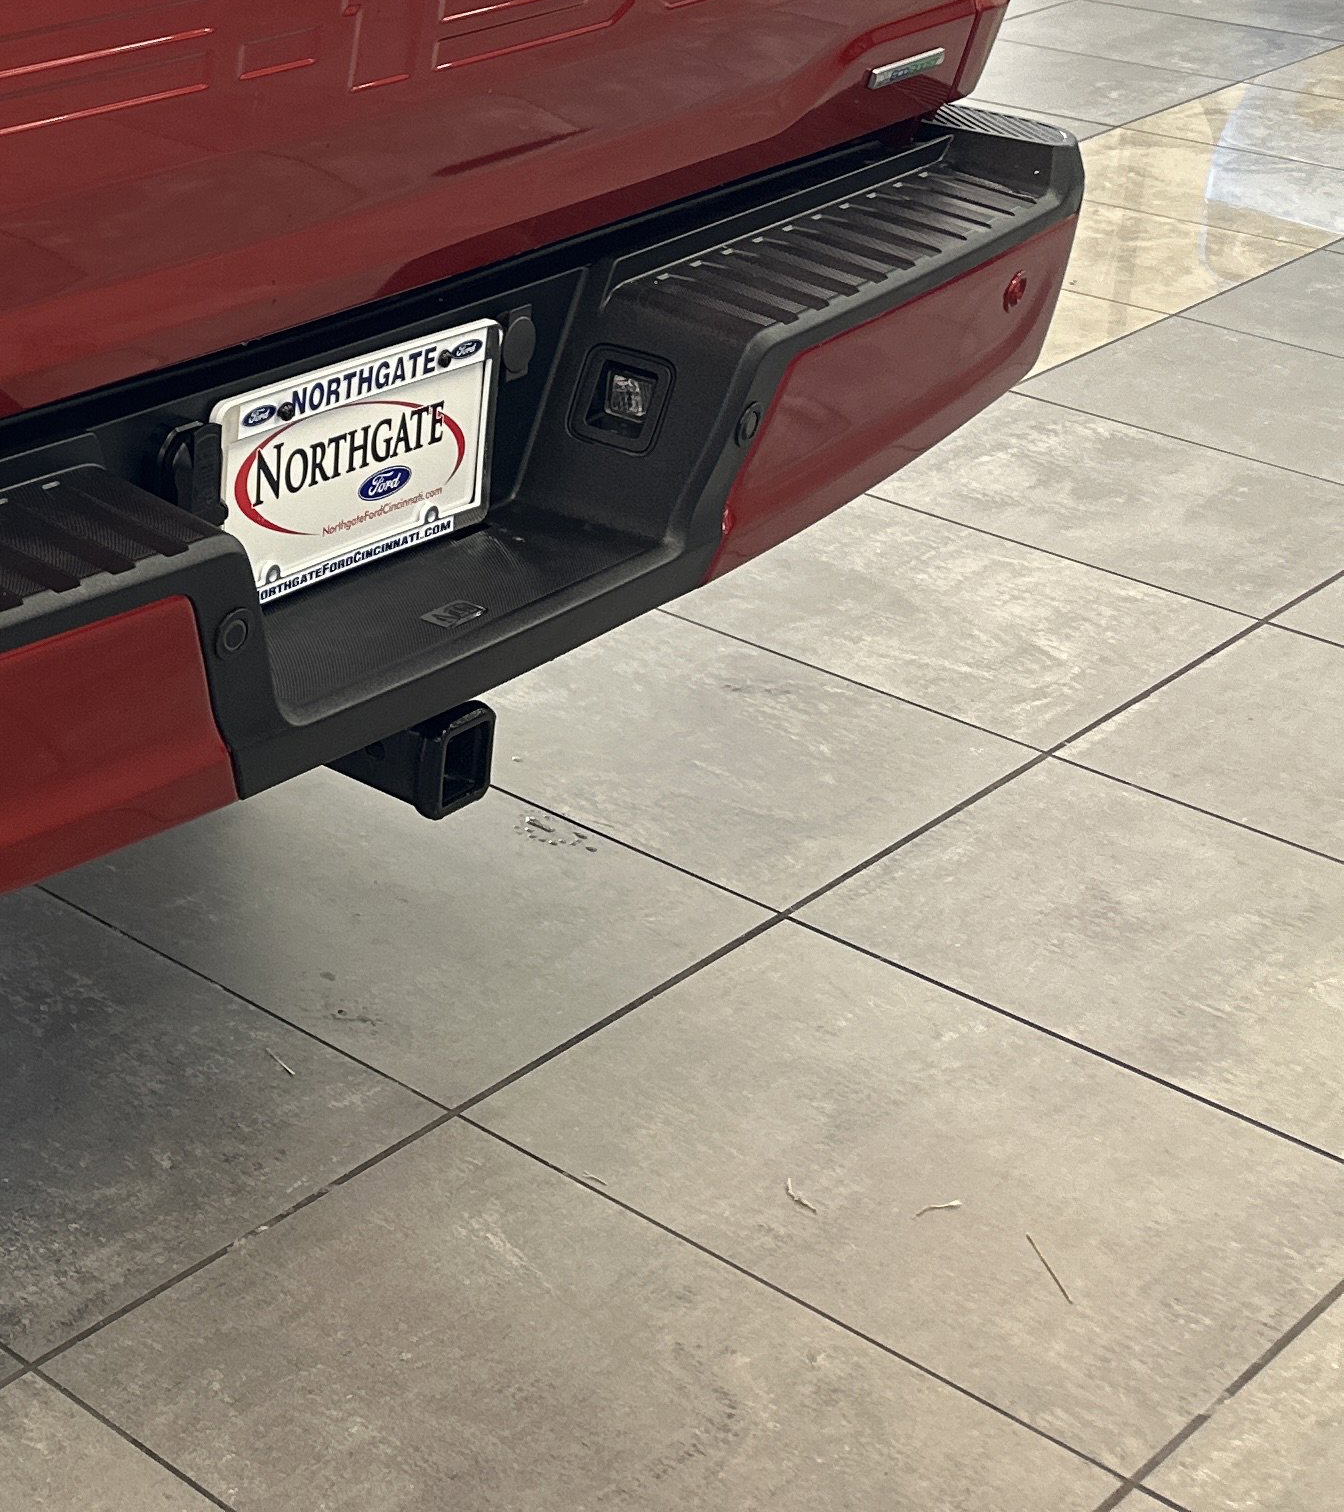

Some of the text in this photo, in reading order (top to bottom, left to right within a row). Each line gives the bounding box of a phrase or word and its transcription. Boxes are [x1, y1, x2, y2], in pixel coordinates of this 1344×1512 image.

[455, 341, 478, 357] Ford
[291, 346, 438, 416] NORTHGATE
[248, 407, 270, 424] Ford
[252, 400, 445, 507] NORTHGATE
[367, 471, 401, 497] Ford
